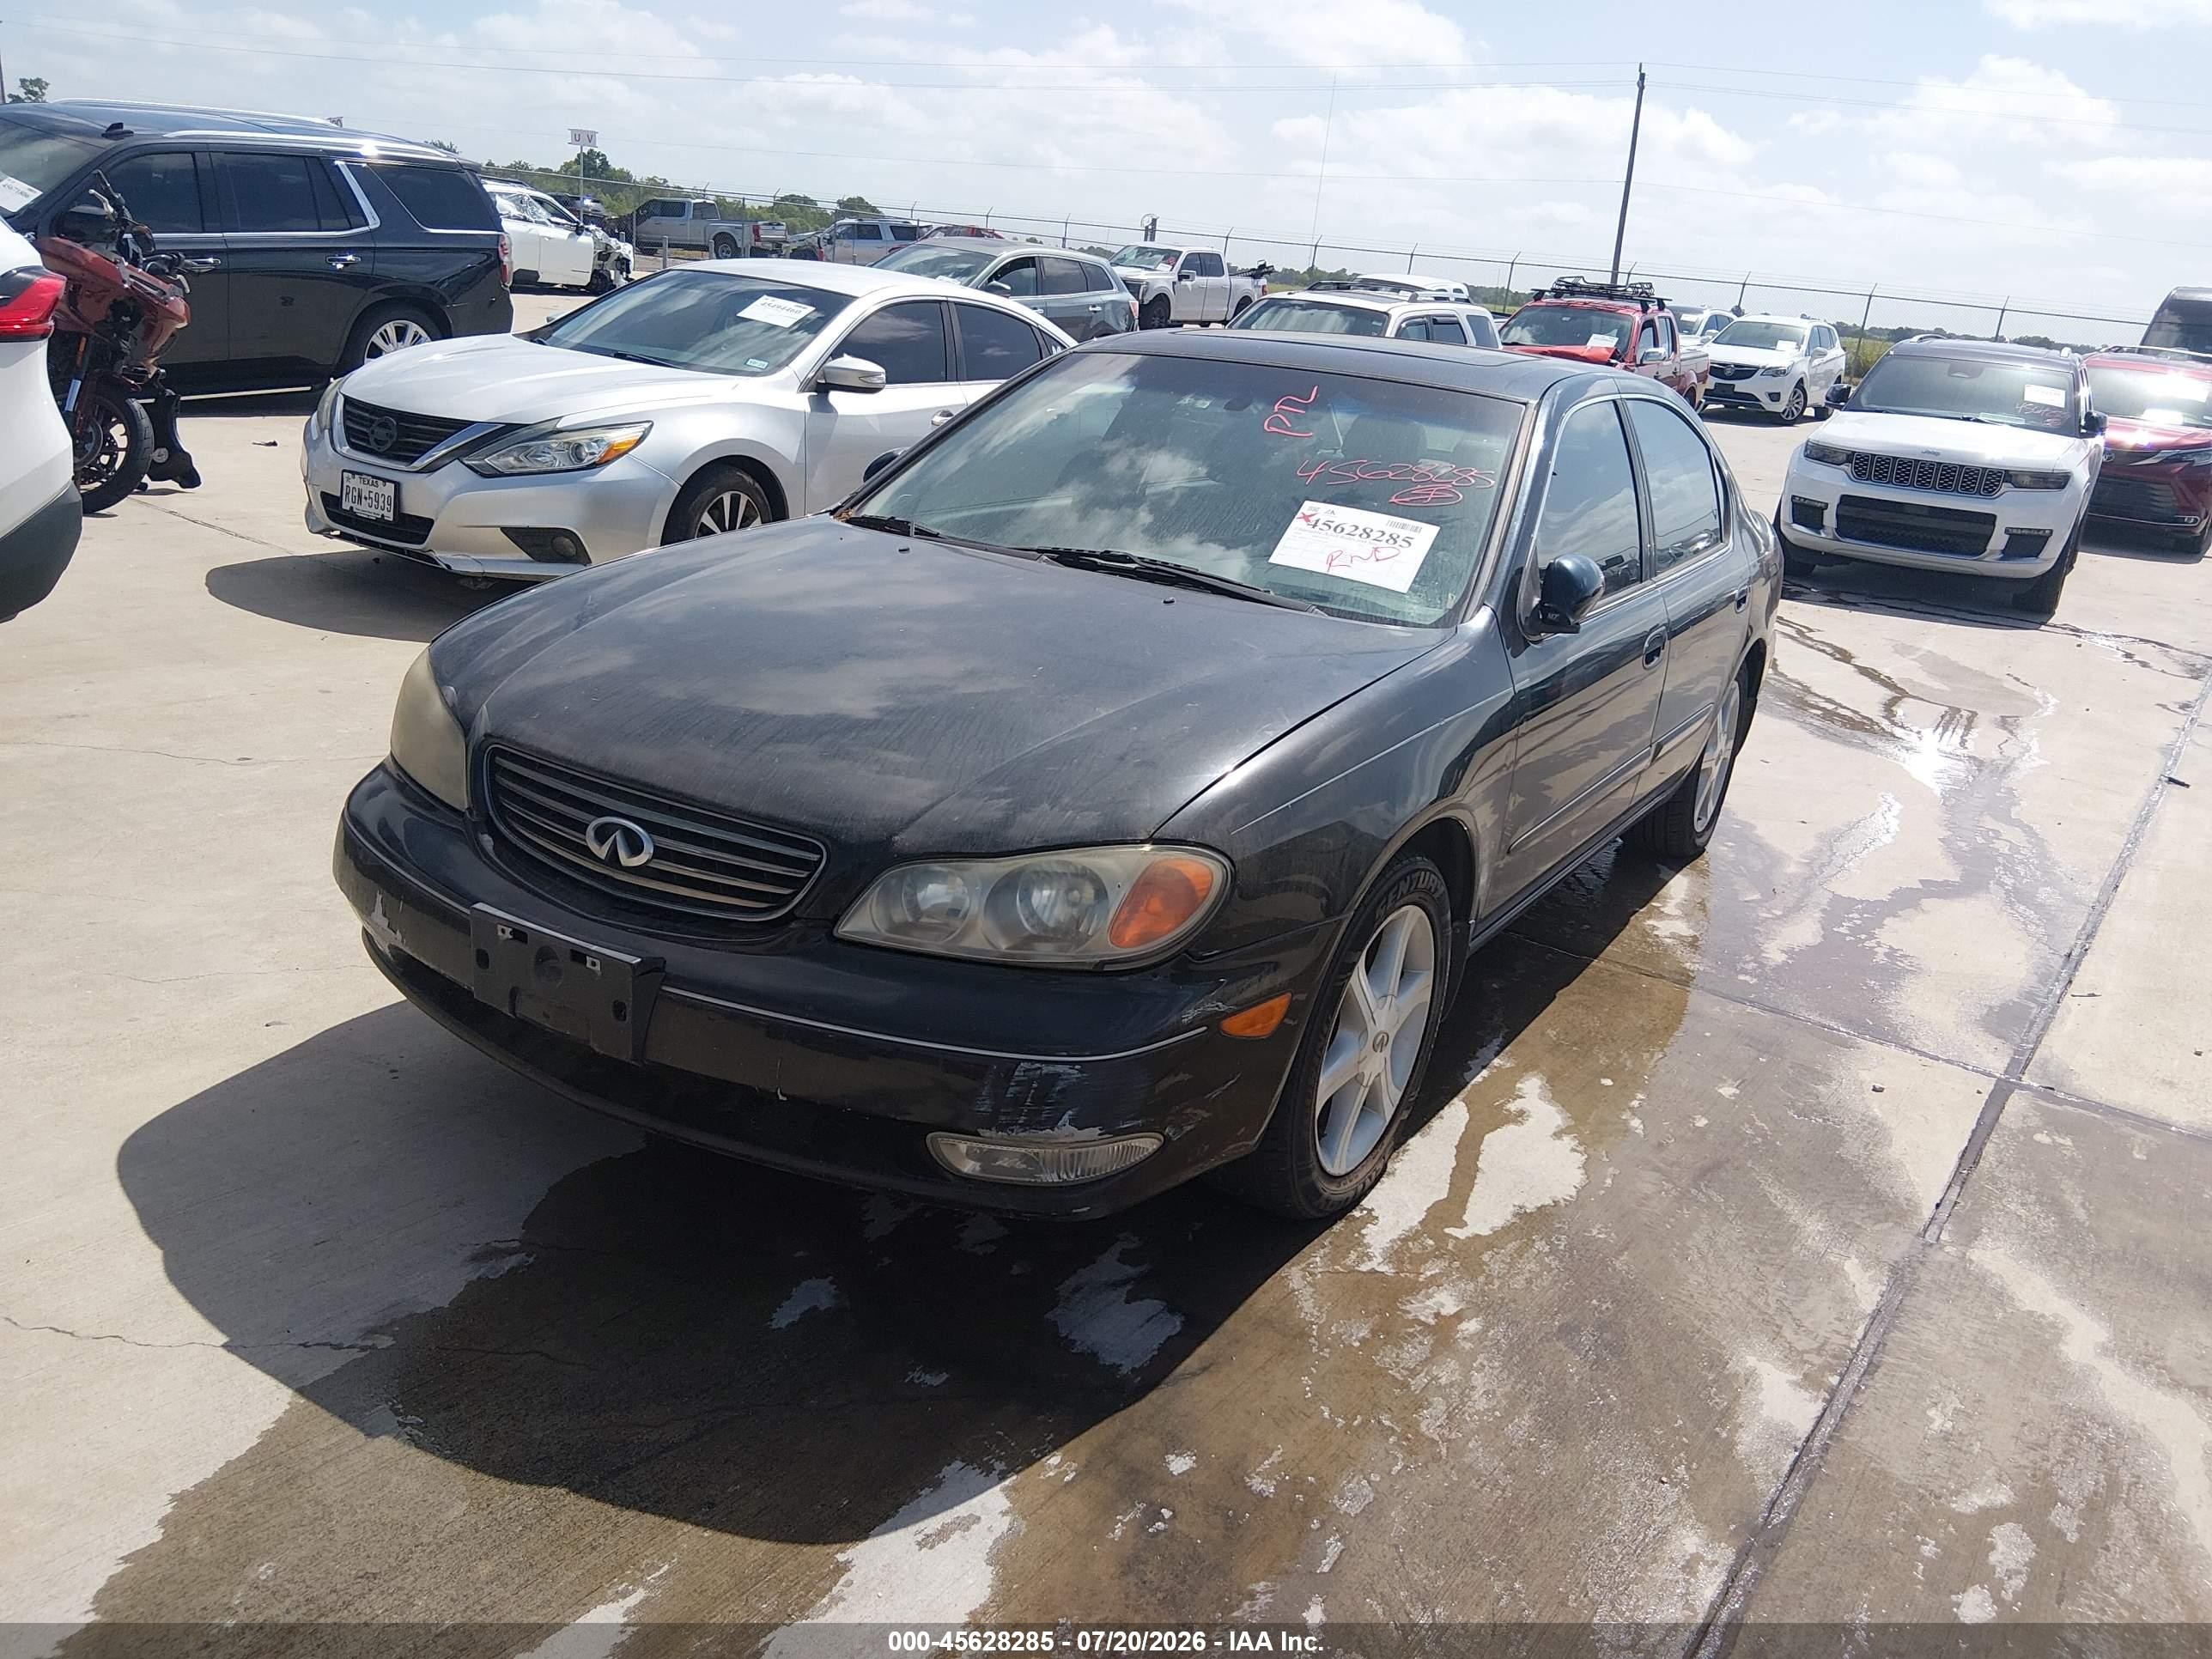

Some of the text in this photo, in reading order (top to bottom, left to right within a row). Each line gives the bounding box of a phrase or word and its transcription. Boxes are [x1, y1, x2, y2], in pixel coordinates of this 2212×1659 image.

[359, 477, 379, 488] TEXAS
[1297, 459, 1495, 489] 45628285
[1306, 518, 1414, 549] 45628285
